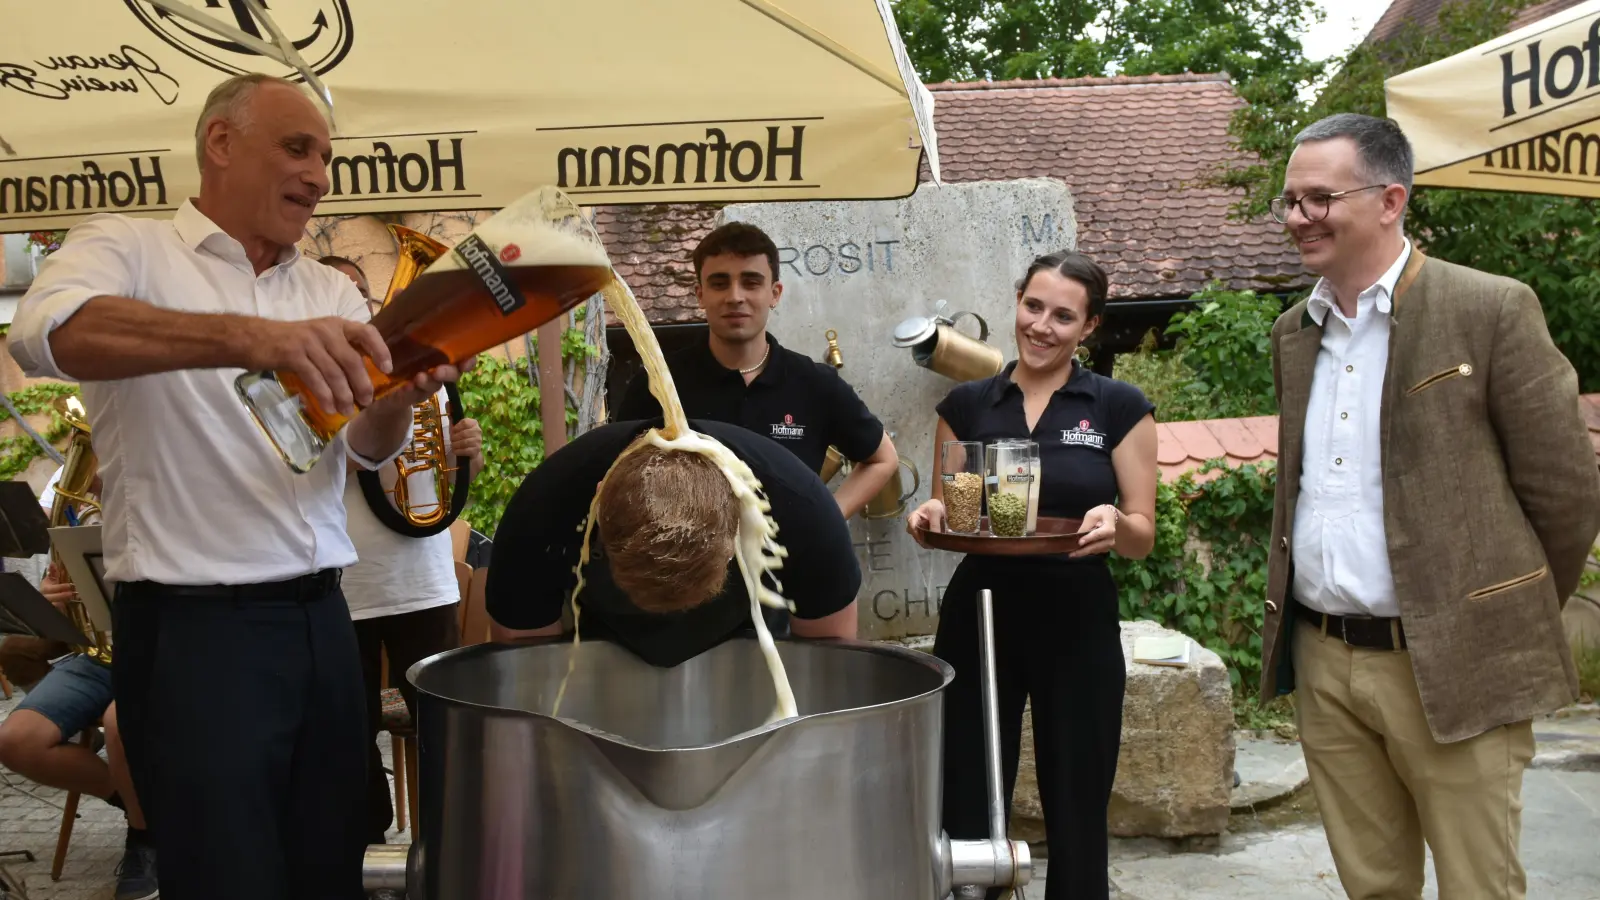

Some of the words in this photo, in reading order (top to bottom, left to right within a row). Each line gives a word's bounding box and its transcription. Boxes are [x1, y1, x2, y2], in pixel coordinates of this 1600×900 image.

[1500, 16, 1600, 118] Hof
[458, 236, 516, 312] Hofmann
[772, 424, 804, 436] Hofmann
[1063, 430, 1104, 445] Hofmann
